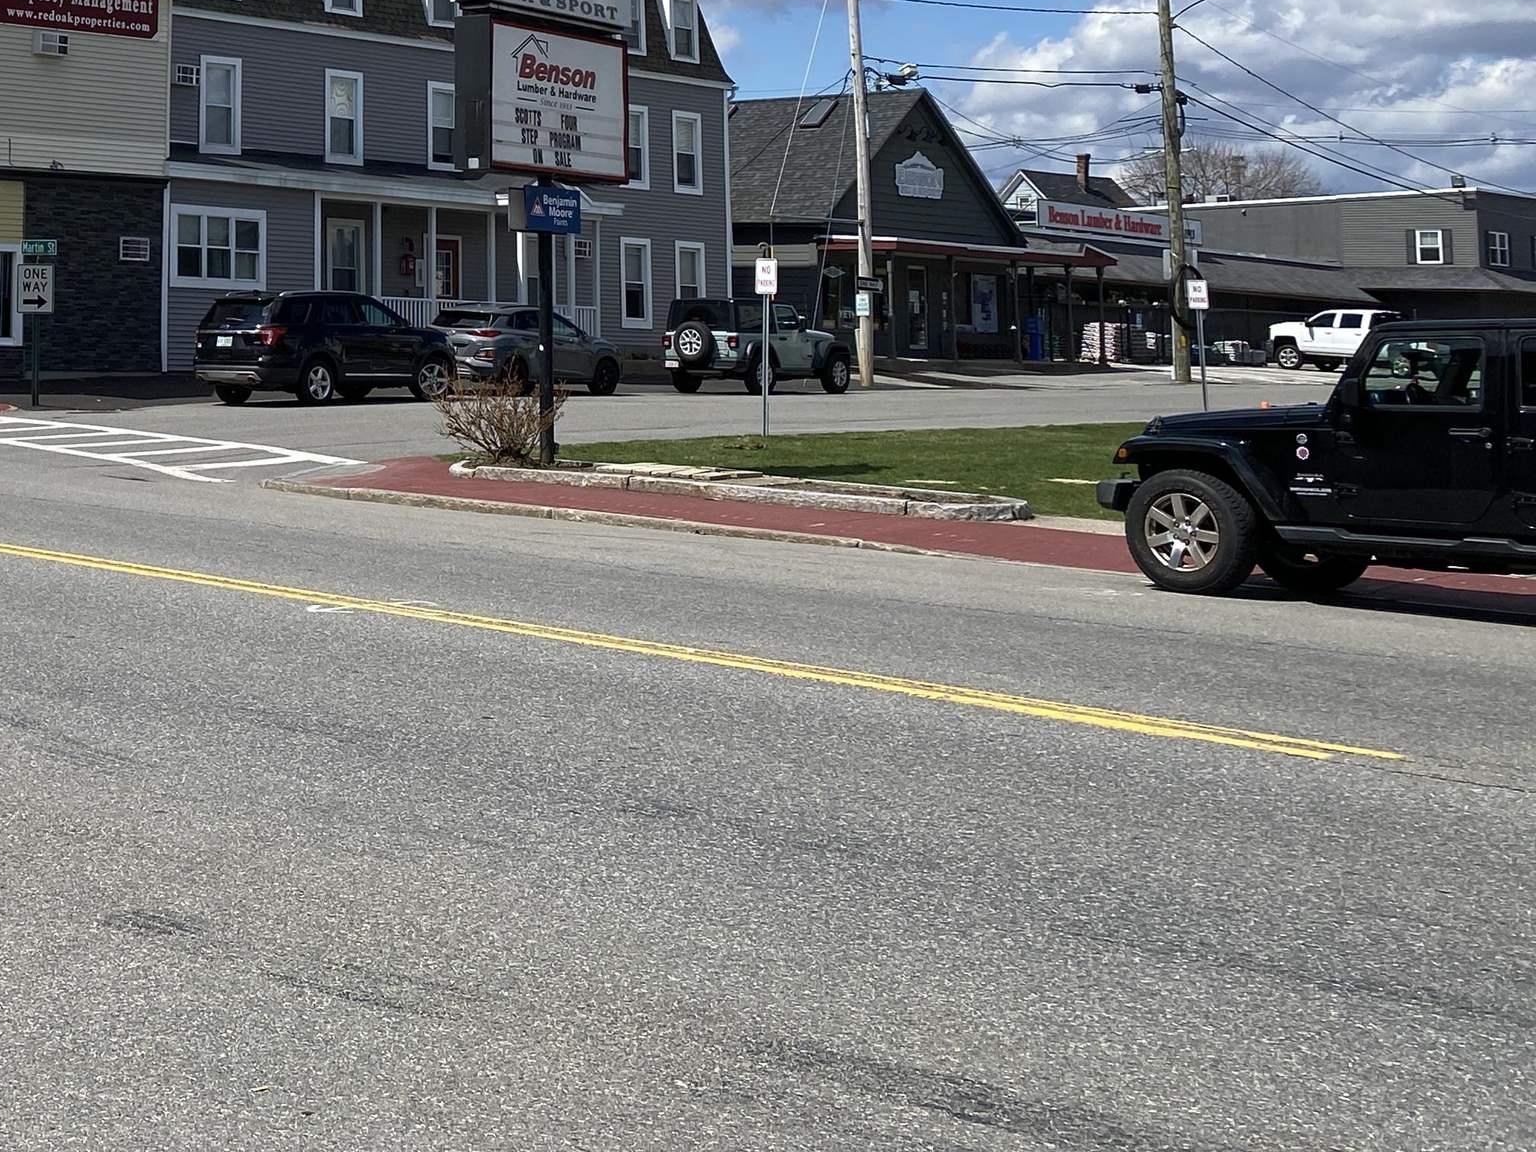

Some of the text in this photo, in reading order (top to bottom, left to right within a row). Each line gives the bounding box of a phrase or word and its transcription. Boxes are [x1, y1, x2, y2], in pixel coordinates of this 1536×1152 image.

[7, 7, 150, 33] www.redoakproperties.com
[518, 53, 597, 90] Benson
[517, 80, 597, 104] Lumber & Hardware
[515, 107, 578, 133] SCOTTS FOUR
[521, 128, 582, 152] STEP PROGRAM
[532, 148, 572, 168] ON SALE
[543, 194, 578, 209] Benjamin
[548, 206, 573, 219] Moore
[1048, 205, 1080, 225] Benson
[1080, 209, 1113, 229] Lumber
[1123, 215, 1163, 236] Hardware
[23, 242, 55, 253] Martin St
[24, 268, 48, 280] ONE
[761, 266, 771, 275] NO
[22, 281, 48, 293] WAY
